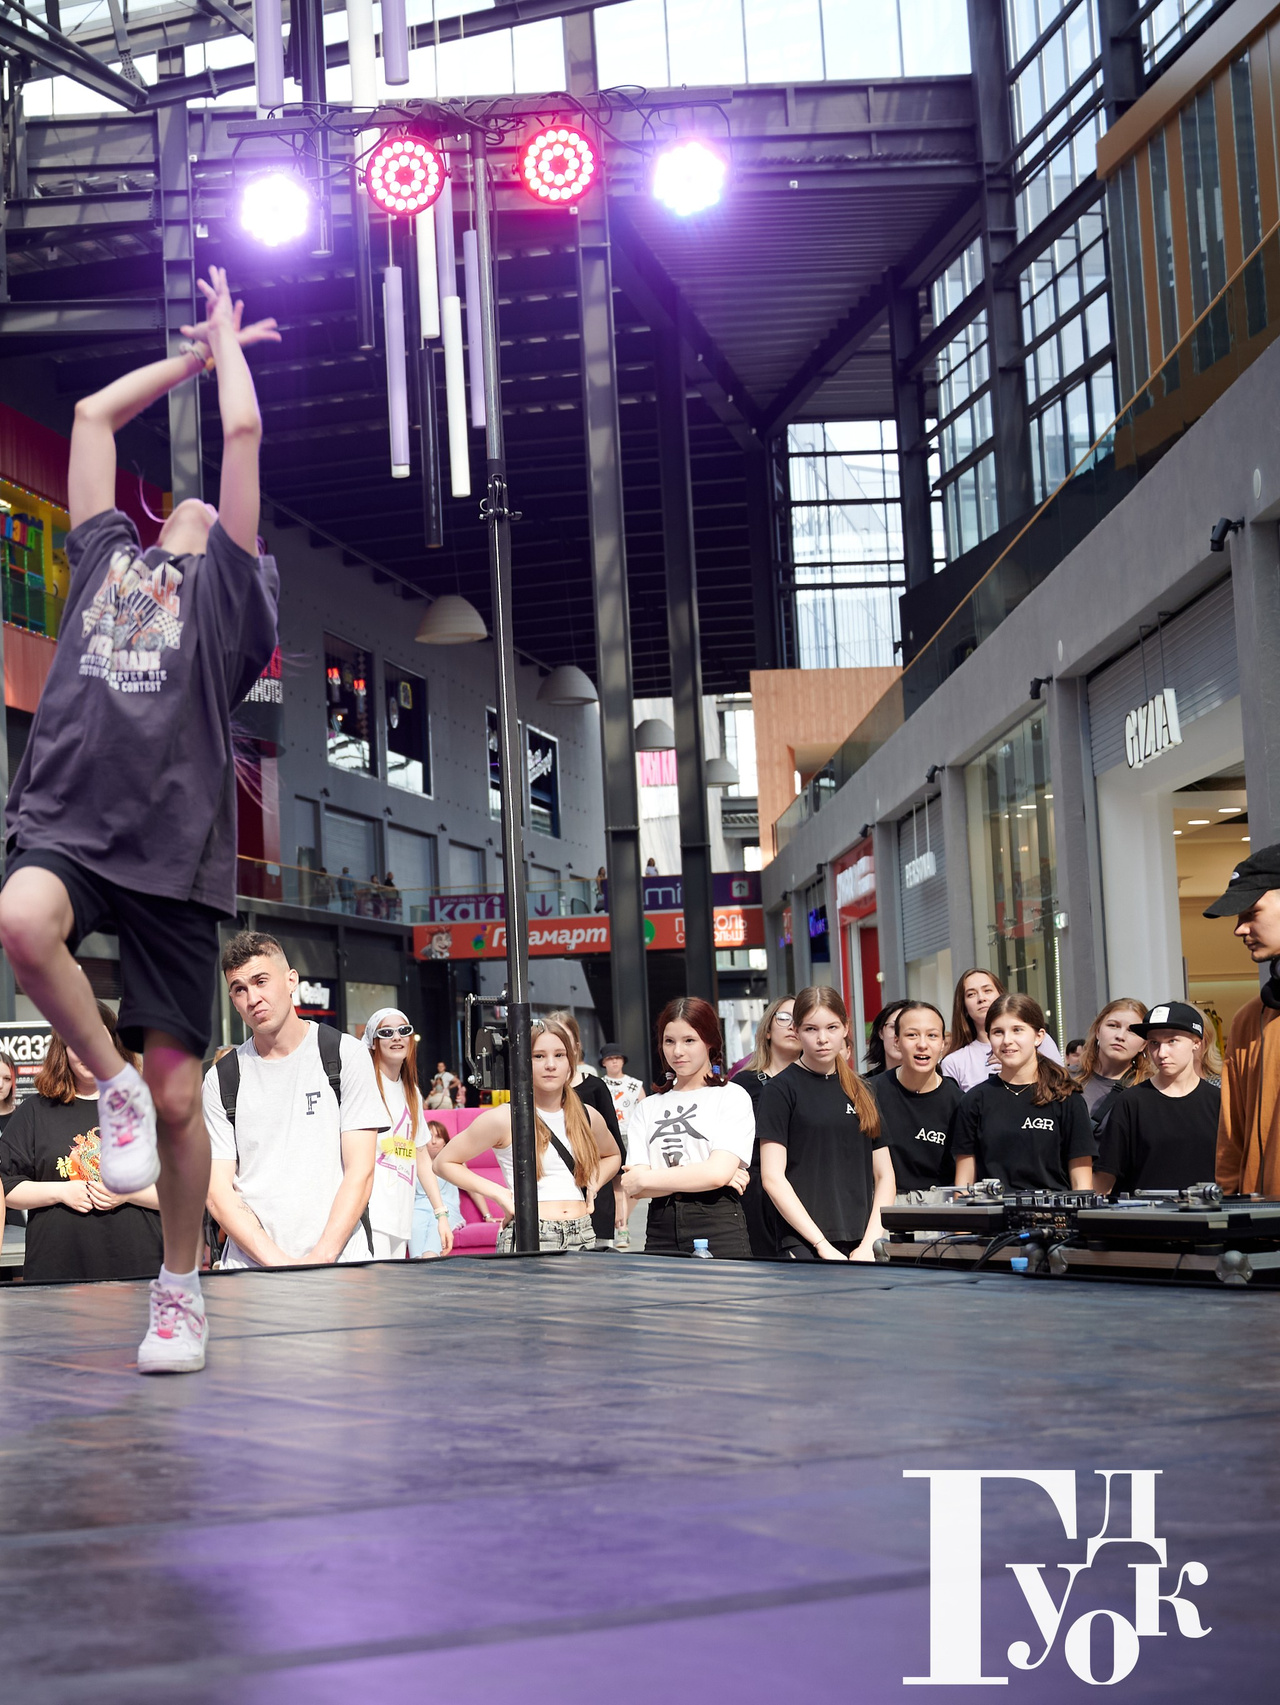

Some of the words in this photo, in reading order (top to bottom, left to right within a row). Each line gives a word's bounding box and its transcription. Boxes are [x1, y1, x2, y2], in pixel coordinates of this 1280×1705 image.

[147, 669, 168, 682] DIE
[121, 680, 163, 693] CONTEST
[433, 896, 501, 922] kari
[492, 926, 607, 950] Гамарт
[305, 1090, 322, 1116] F
[1021, 1116, 1055, 1132] AGR
[915, 1127, 947, 1146] AGR
[394, 1147, 413, 1158] ATTLE
